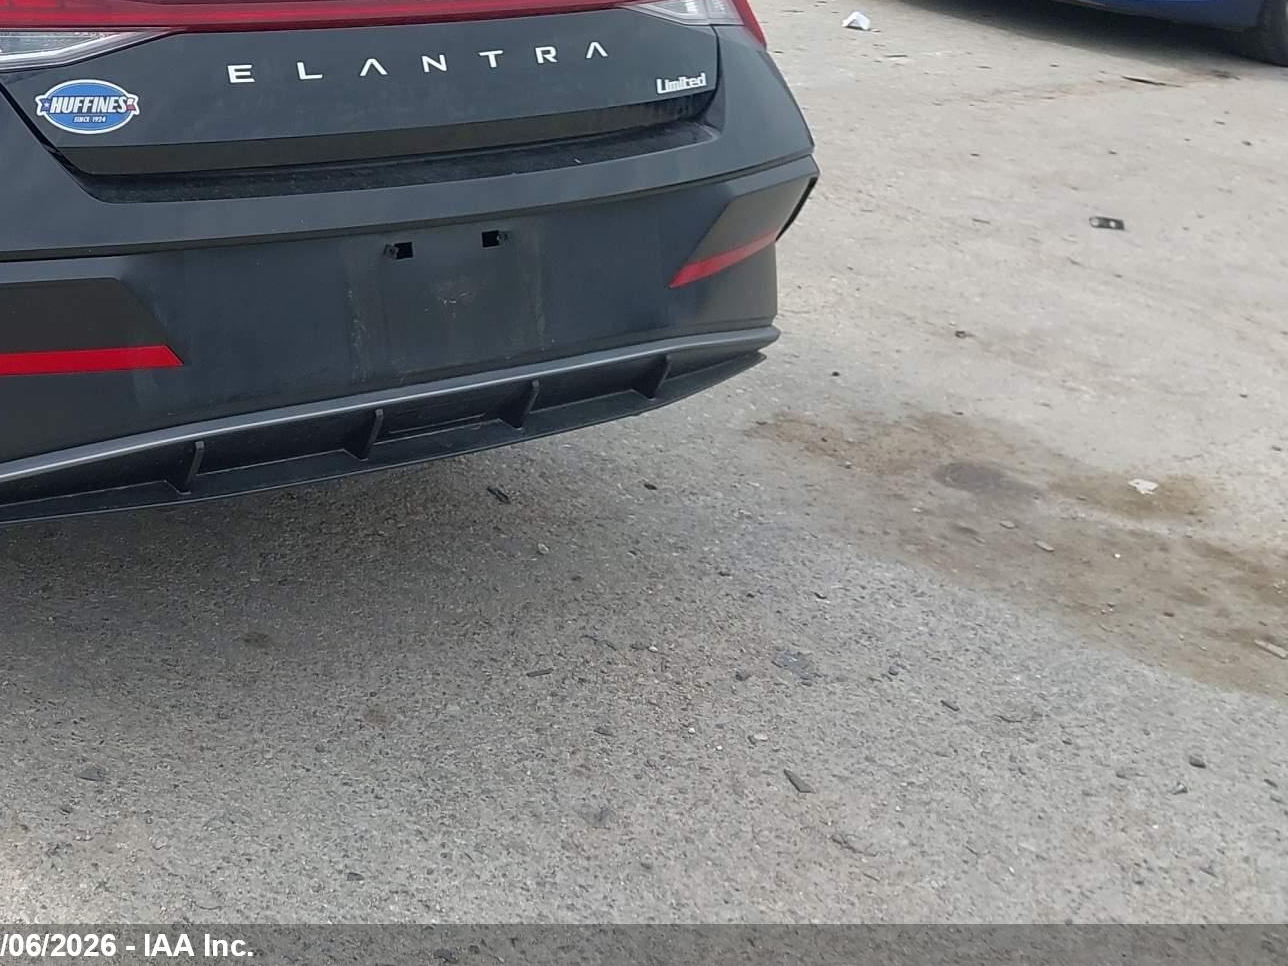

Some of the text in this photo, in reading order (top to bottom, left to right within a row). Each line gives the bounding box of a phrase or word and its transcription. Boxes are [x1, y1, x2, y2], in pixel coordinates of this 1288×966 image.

[227, 41, 609, 84] ELANTRA
[656, 72, 707, 94] Limited
[49, 96, 127, 113] HUFFINES
[73, 115, 90, 123] SINCE
